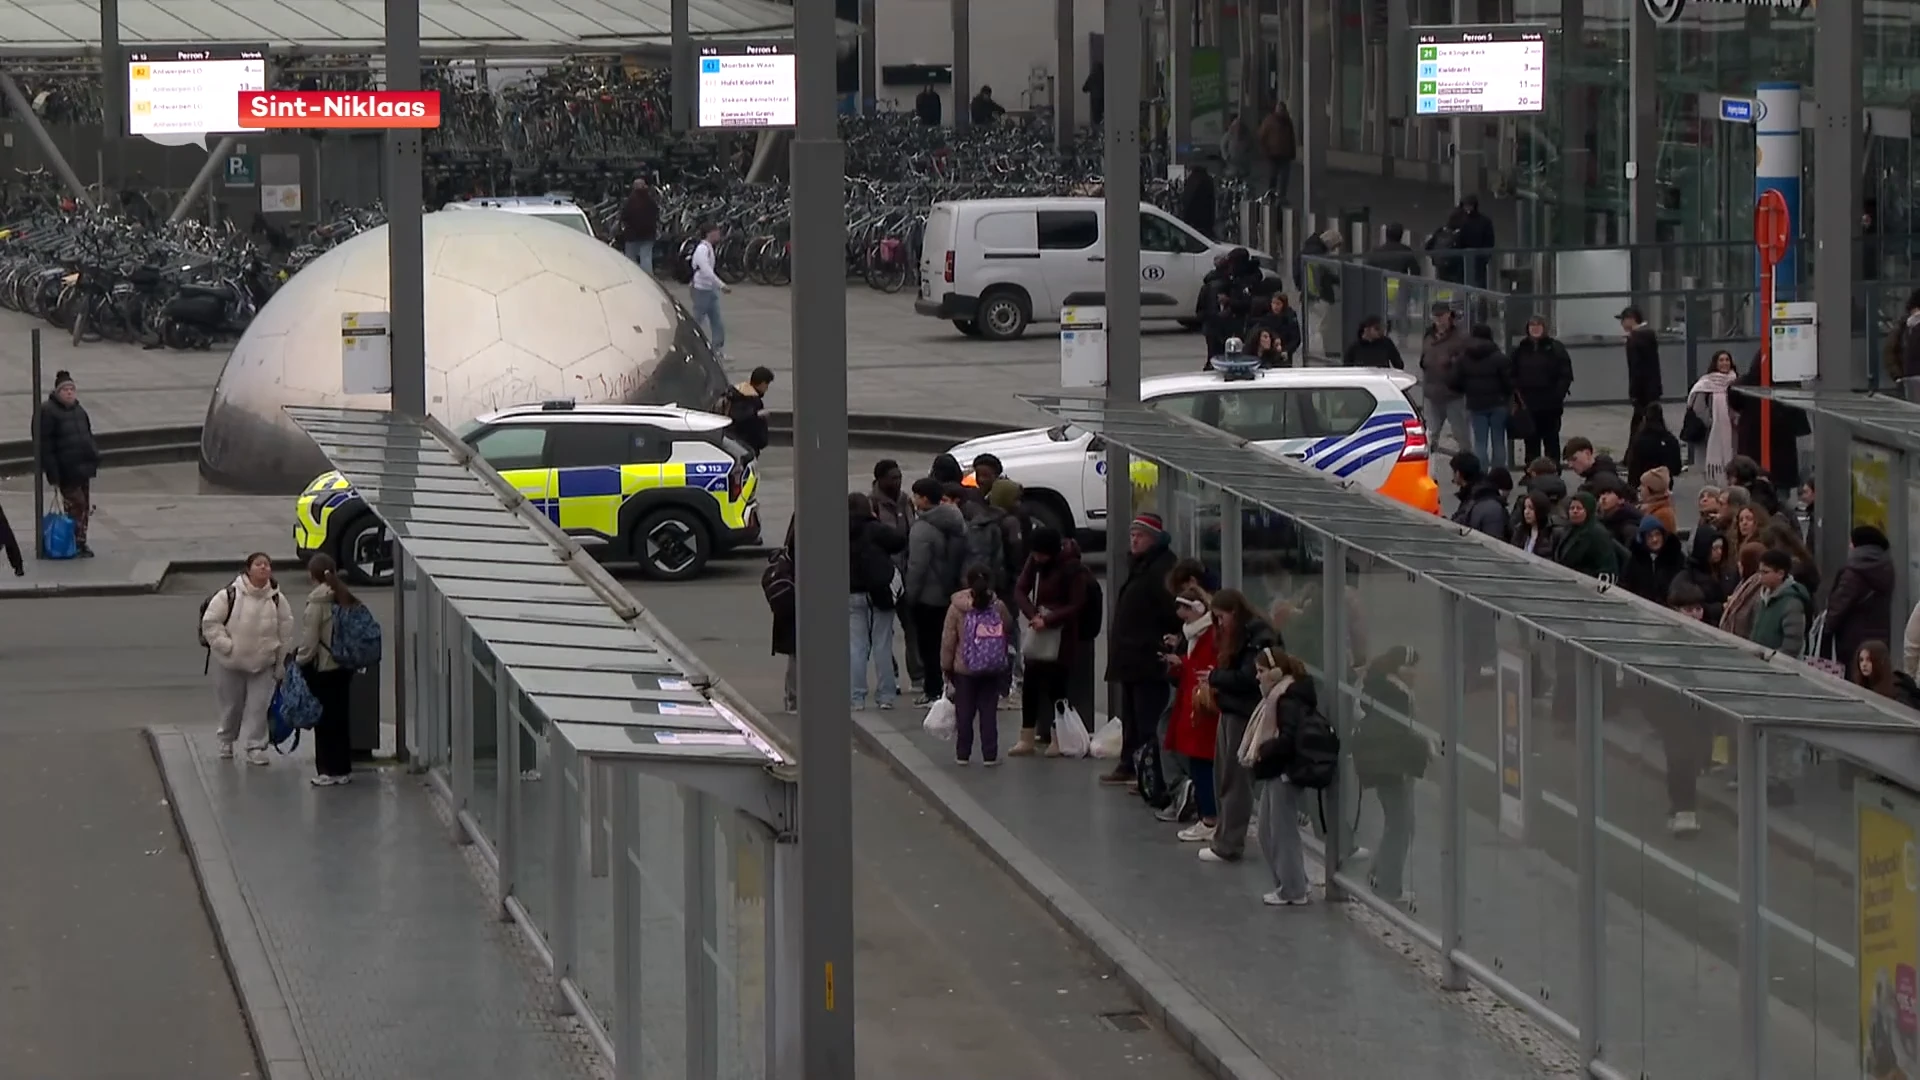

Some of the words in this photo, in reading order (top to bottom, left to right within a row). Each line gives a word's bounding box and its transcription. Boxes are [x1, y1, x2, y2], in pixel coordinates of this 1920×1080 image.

[1488, 33, 1493, 41] 5
[1524, 46, 1529, 54] 2
[178, 52, 203, 60] Perron
[204, 51, 210, 59] 7
[1423, 84, 1432, 92] 21
[229, 157, 243, 175] P
